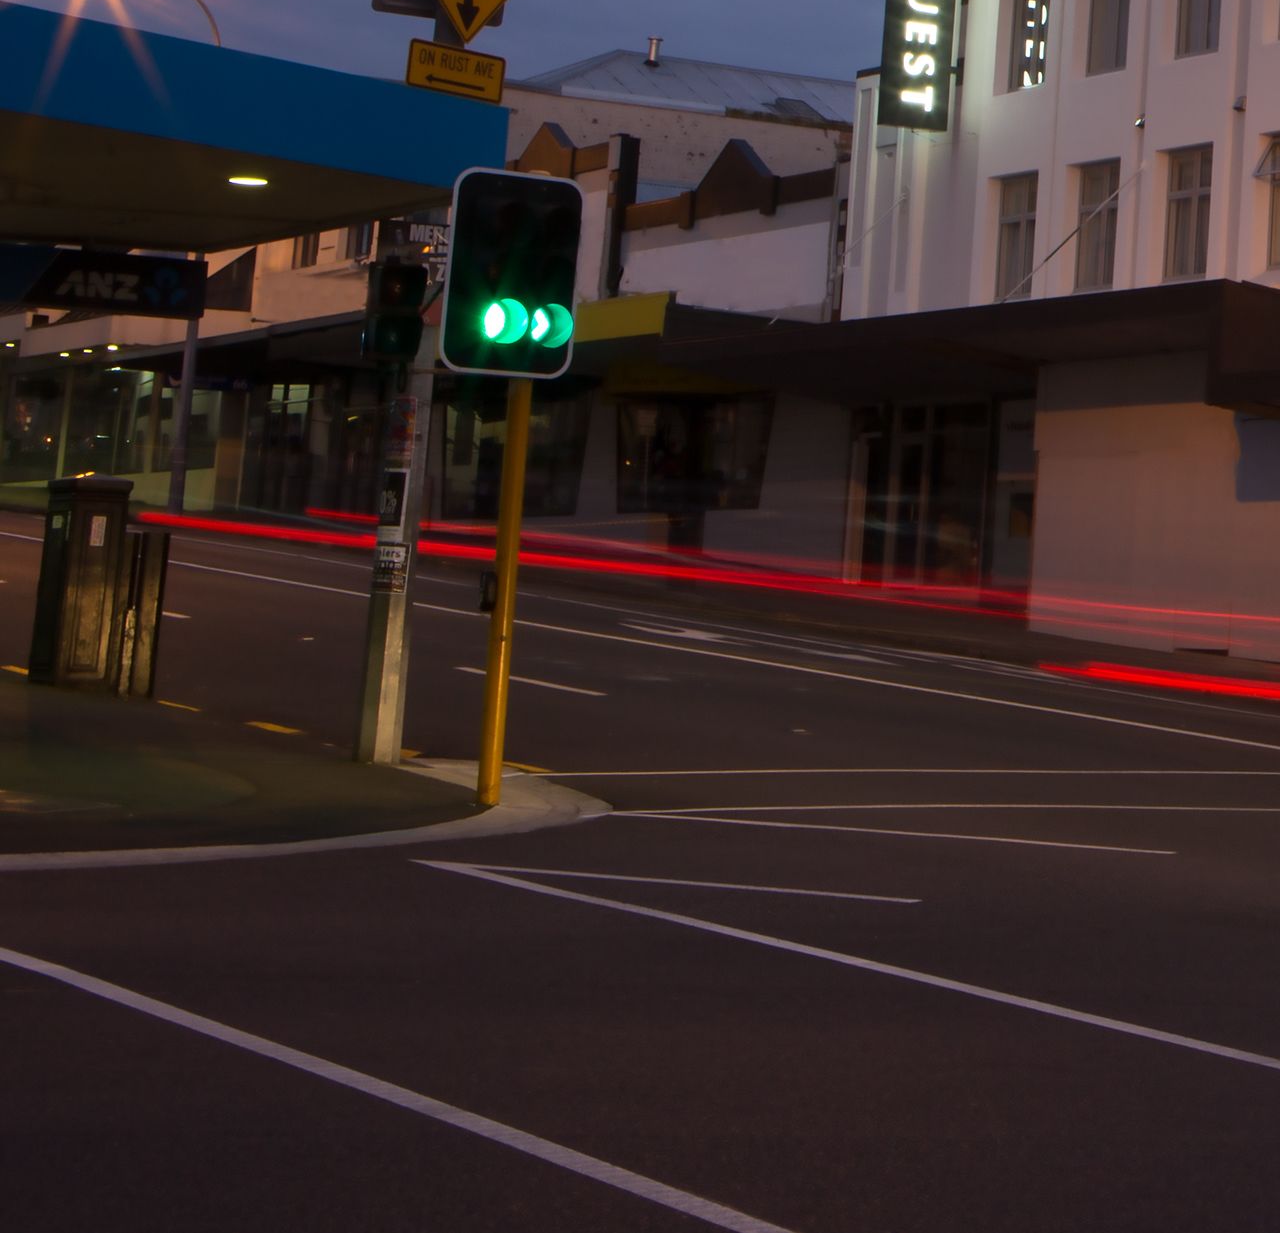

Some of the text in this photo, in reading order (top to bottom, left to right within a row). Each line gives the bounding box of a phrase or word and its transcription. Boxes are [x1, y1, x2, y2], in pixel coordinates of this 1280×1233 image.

[419, 48, 495, 79] ON RUST AVE
[56, 269, 140, 300] ANZ
